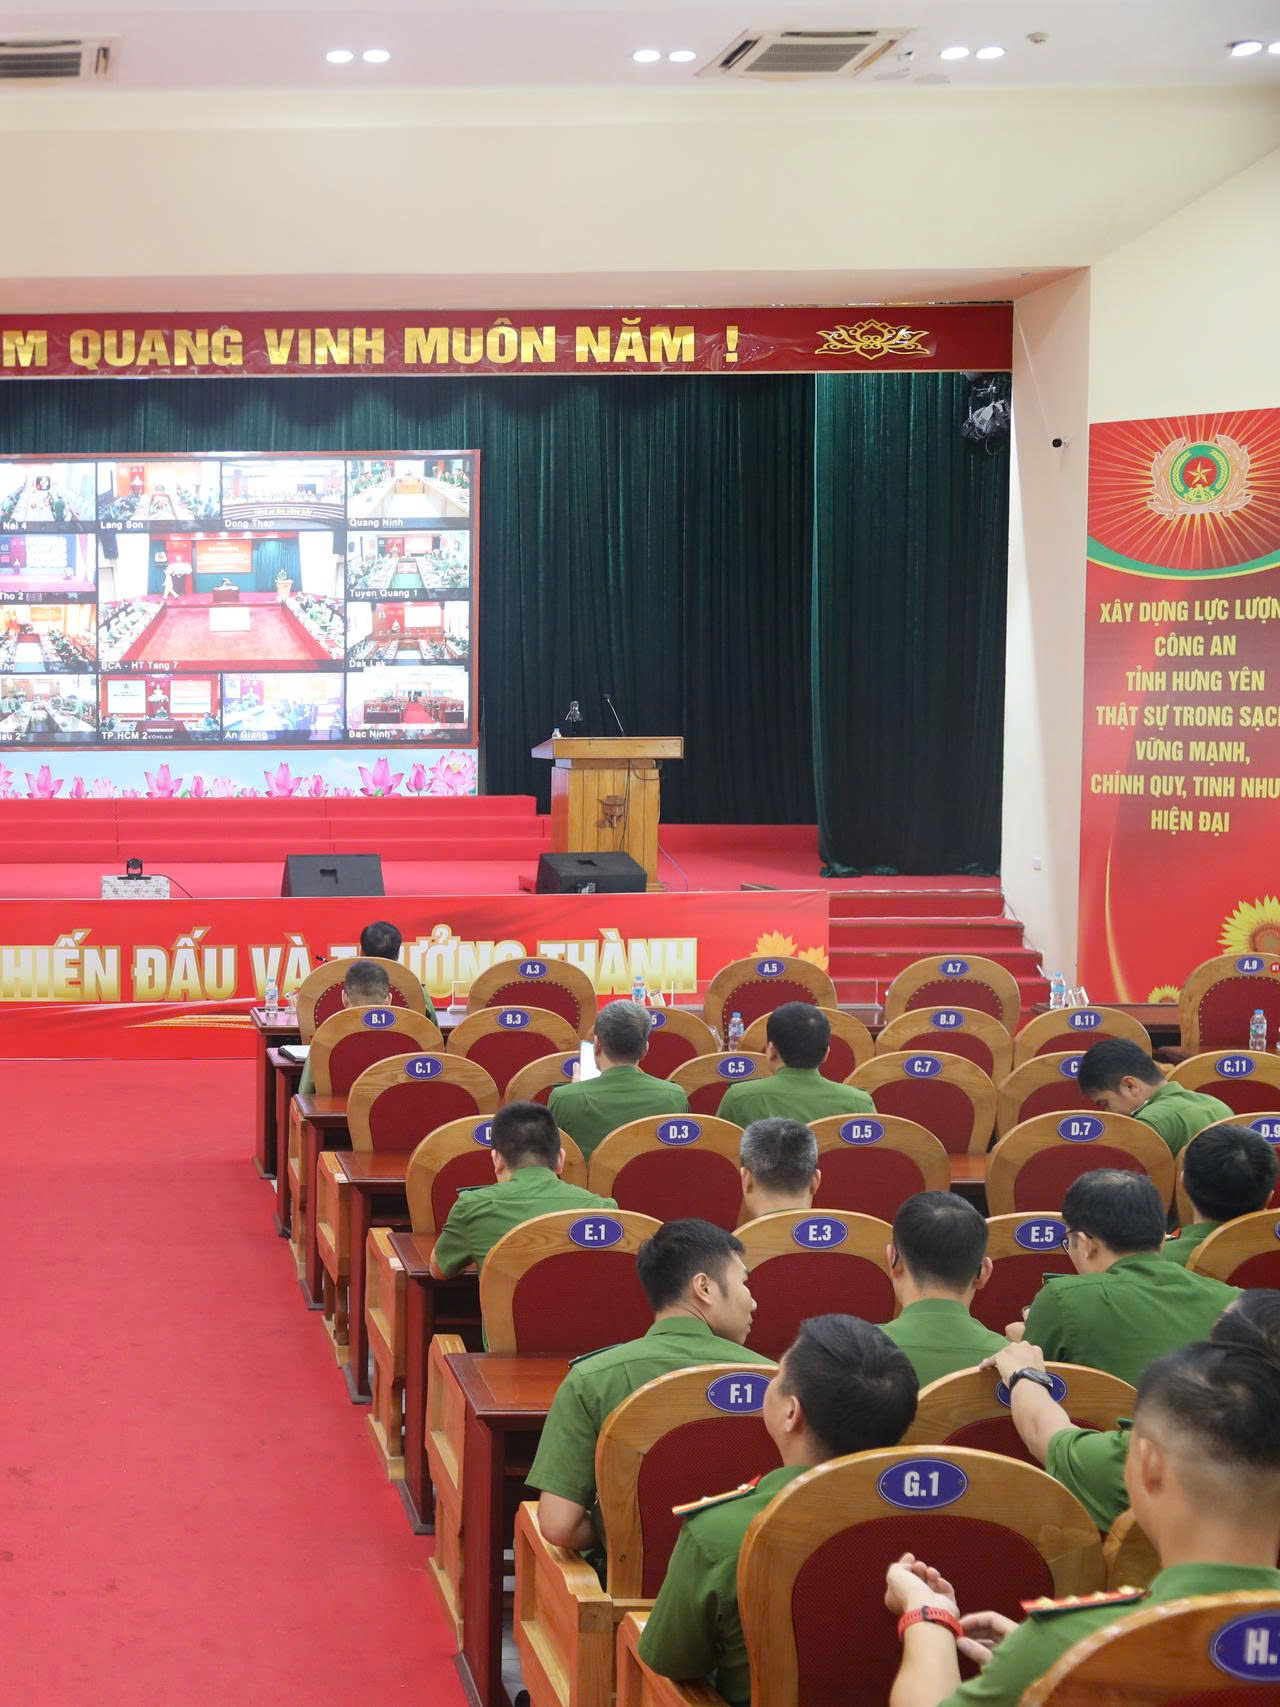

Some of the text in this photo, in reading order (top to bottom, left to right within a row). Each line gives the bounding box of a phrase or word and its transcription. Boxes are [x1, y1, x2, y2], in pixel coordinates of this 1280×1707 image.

[69, 326, 243, 366] QUANG
[265, 325, 386, 365] VINH
[403, 317, 556, 364] MUÔN
[575, 315, 695, 364] NĂM
[725, 325, 739, 363] !
[3, 522, 19, 530] Nai
[21, 522, 27, 530] 4
[100, 521, 144, 531] Lang Son
[224, 519, 249, 530] Dong
[350, 518, 403, 528] Quang Ninh
[18, 592, 24, 600] 2
[350, 589, 418, 599] Tuyen Quang 1
[1100, 599, 1133, 623] XÂY
[1139, 599, 1188, 626] DỰNG
[1194, 598, 1228, 626] LỰC
[1154, 632, 1236, 657] CÔNG AN
[101, 661, 122, 670] BCA
[132, 661, 145, 670] HT
[148, 661, 170, 671] Tang
[173, 661, 179, 669] 7
[349, 659, 366, 668] Dak
[1126, 665, 1265, 692] TỈNH HƯNG YÊN
[1096, 702, 1280, 731] THẬT SỰ TRONG SẠC
[16, 732, 21, 740] 2
[101, 731, 148, 740] TP.HCM 2
[224, 731, 267, 740] An Giang
[349, 730, 391, 738] Bac Ninh
[1135, 737, 1250, 765] VỮNG MẠNH,
[1090, 770, 1144, 796] CHÍNH
[1150, 775, 1187, 799] QUY,
[1193, 776, 1235, 797] TINH
[1151, 806, 1229, 836] HIỆN ĐẠI
[131, 926, 238, 1001] ĐẤU
[250, 933, 312, 1000] VÀ
[526, 965, 539, 974] A.3
[763, 963, 777, 973] A.5
[947, 963, 961, 973] A.7
[1244, 960, 1258, 970] A.9
[372, 1013, 385, 1024] B.1
[506, 1014, 521, 1025] B.3
[940, 1015, 955, 1025] B.9
[1075, 1015, 1095, 1025] B.11
[415, 1062, 431, 1074] C.1
[728, 1061, 744, 1073] C.5
[914, 1061, 931, 1072] C.7
[1224, 1060, 1247, 1072] C.11
[669, 1126, 688, 1139] D.3
[852, 1126, 872, 1139] D.5
[1071, 1122, 1091, 1135] D.7
[1261, 1124, 1280, 1138] D.9
[585, 1224, 606, 1240] E.1
[809, 1225, 832, 1241] E.3
[1031, 1226, 1054, 1242] E.5
[730, 1384, 753, 1404] F.1
[904, 1471, 940, 1497] G.1
[1246, 1628, 1280, 1665] H.
